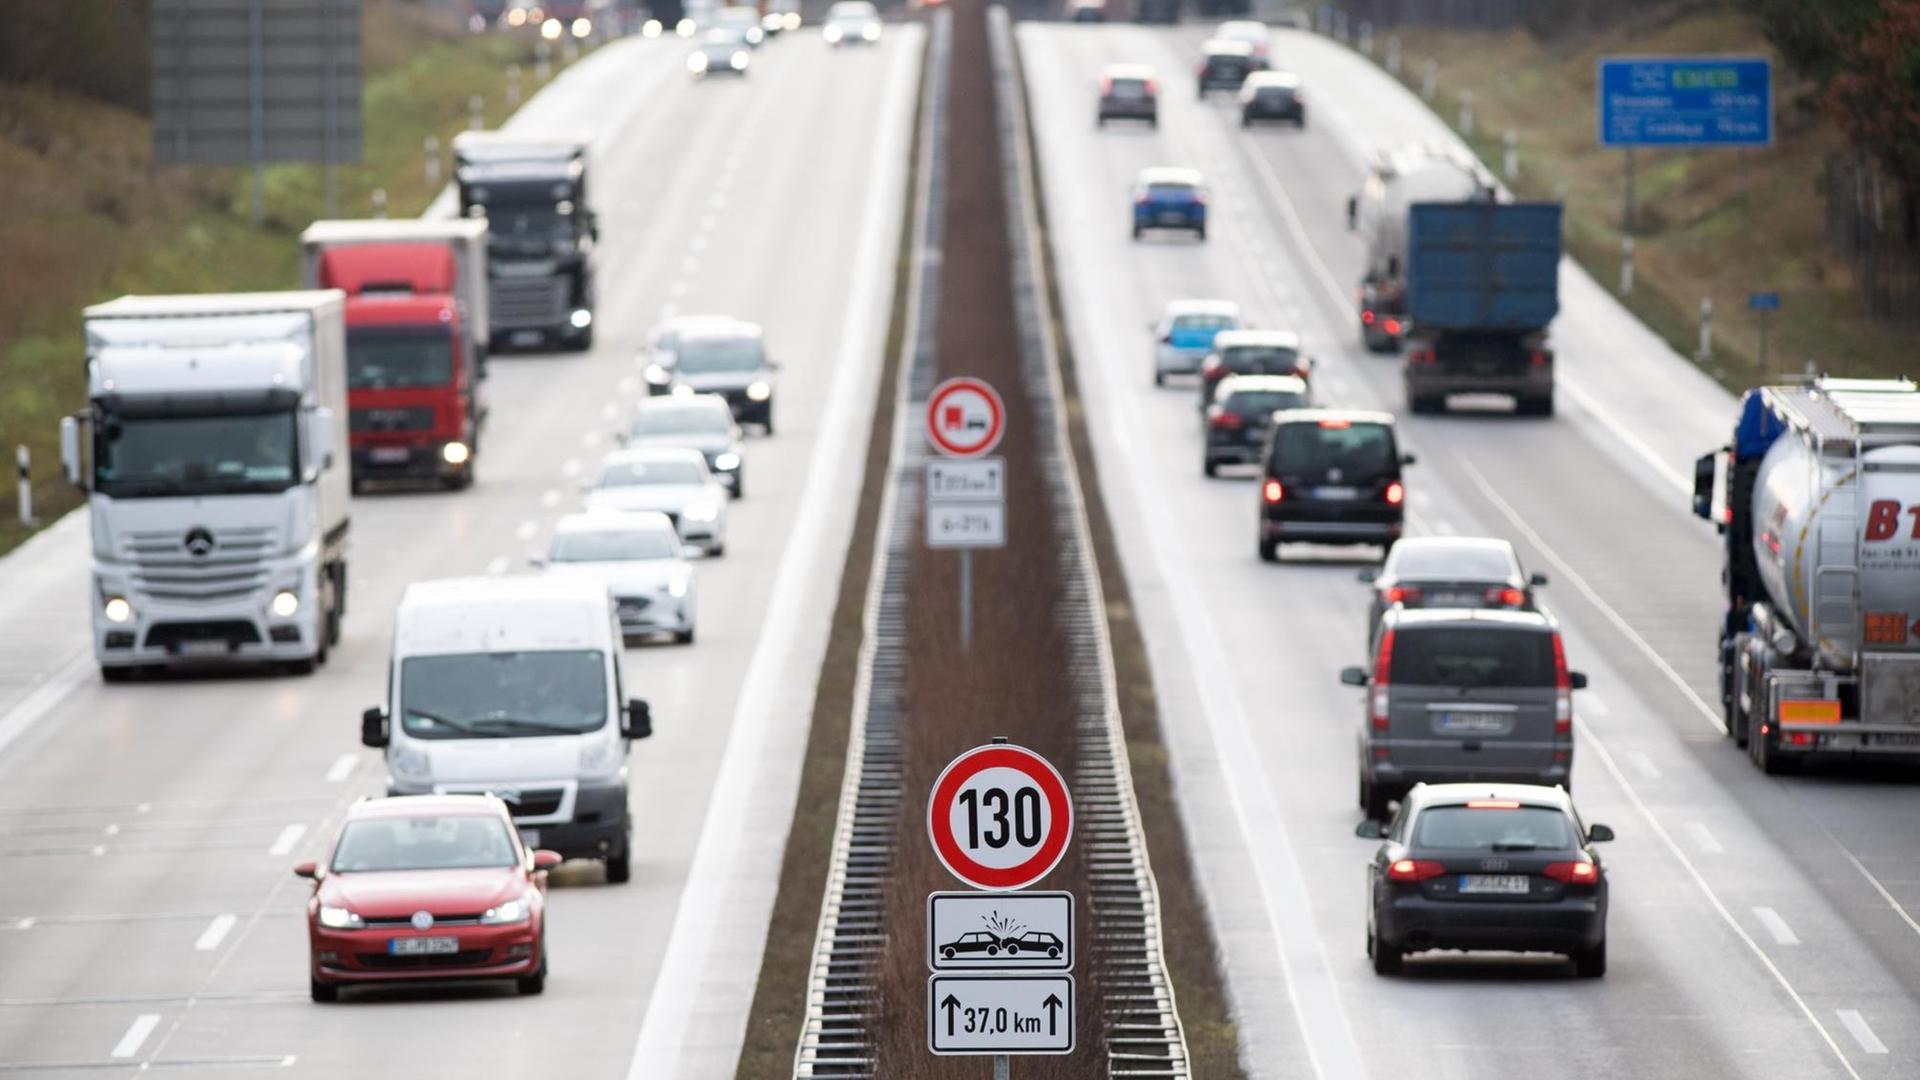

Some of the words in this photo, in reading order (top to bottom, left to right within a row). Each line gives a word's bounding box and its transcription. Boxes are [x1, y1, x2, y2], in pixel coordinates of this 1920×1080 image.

[959, 786, 1042, 849] 130
[964, 1007, 1007, 1035] 37,0
[1014, 1012, 1041, 1033] km
